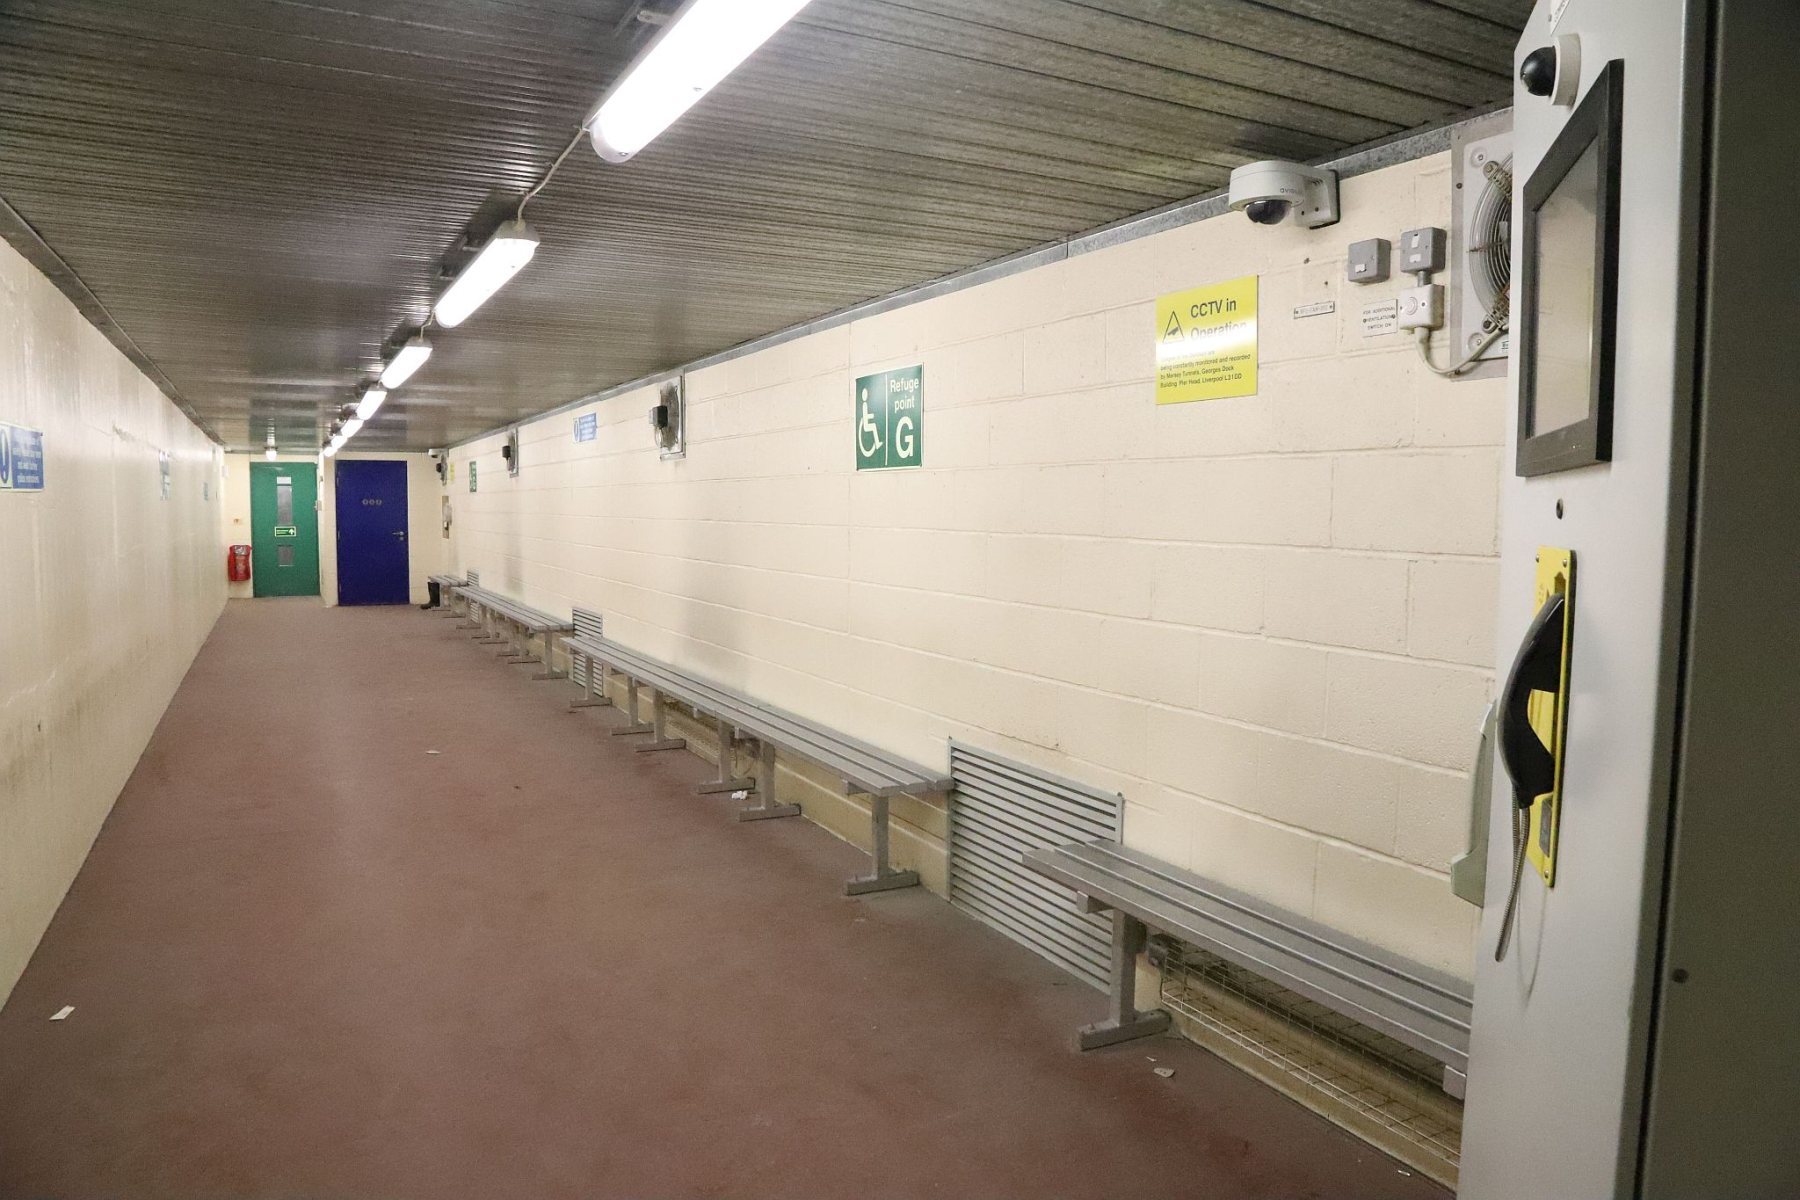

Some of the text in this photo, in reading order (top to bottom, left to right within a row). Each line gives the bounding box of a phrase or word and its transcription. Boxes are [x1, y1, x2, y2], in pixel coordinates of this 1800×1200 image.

[1190, 298, 1237, 318] CCTV in
[890, 378, 919, 392] Refuge
[894, 395, 915, 413] point
[895, 415, 914, 459] G
